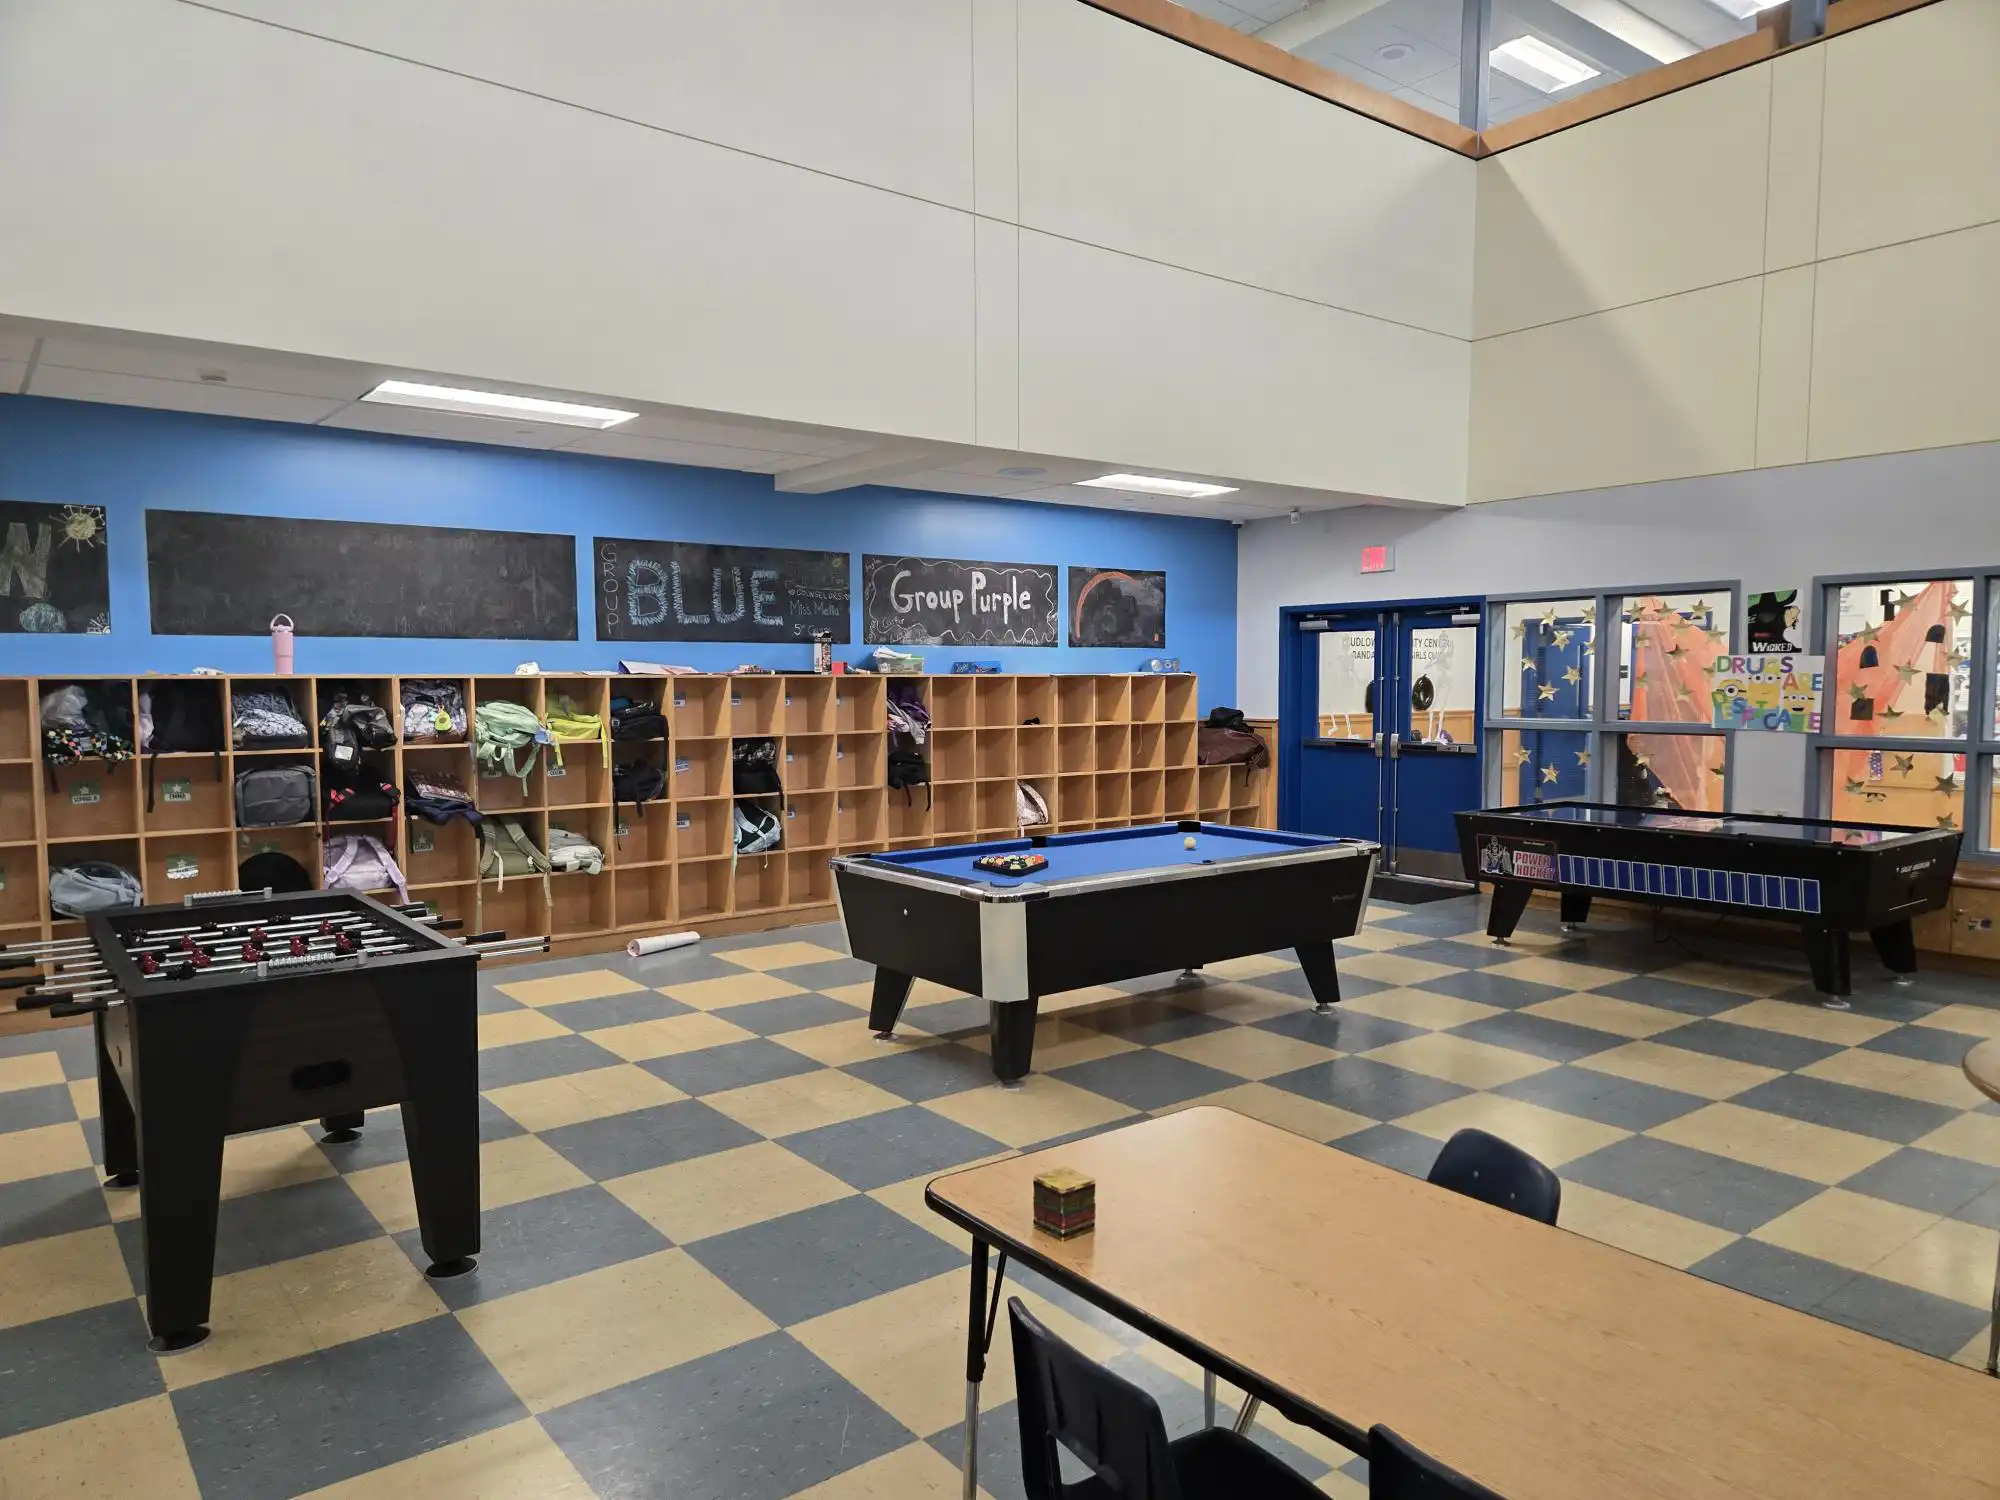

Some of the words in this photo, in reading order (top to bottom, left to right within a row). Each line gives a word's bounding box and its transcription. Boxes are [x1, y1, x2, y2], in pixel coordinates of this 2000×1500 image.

[600, 542, 619, 635] GROUP
[627, 559, 783, 626] BLUE
[890, 570, 963, 624] Group
[971, 571, 1031, 625] Purple
[789, 599, 811, 616] Miss
[1514, 851, 1550, 868] POWER
[1515, 863, 1556, 880] HOCKEY
